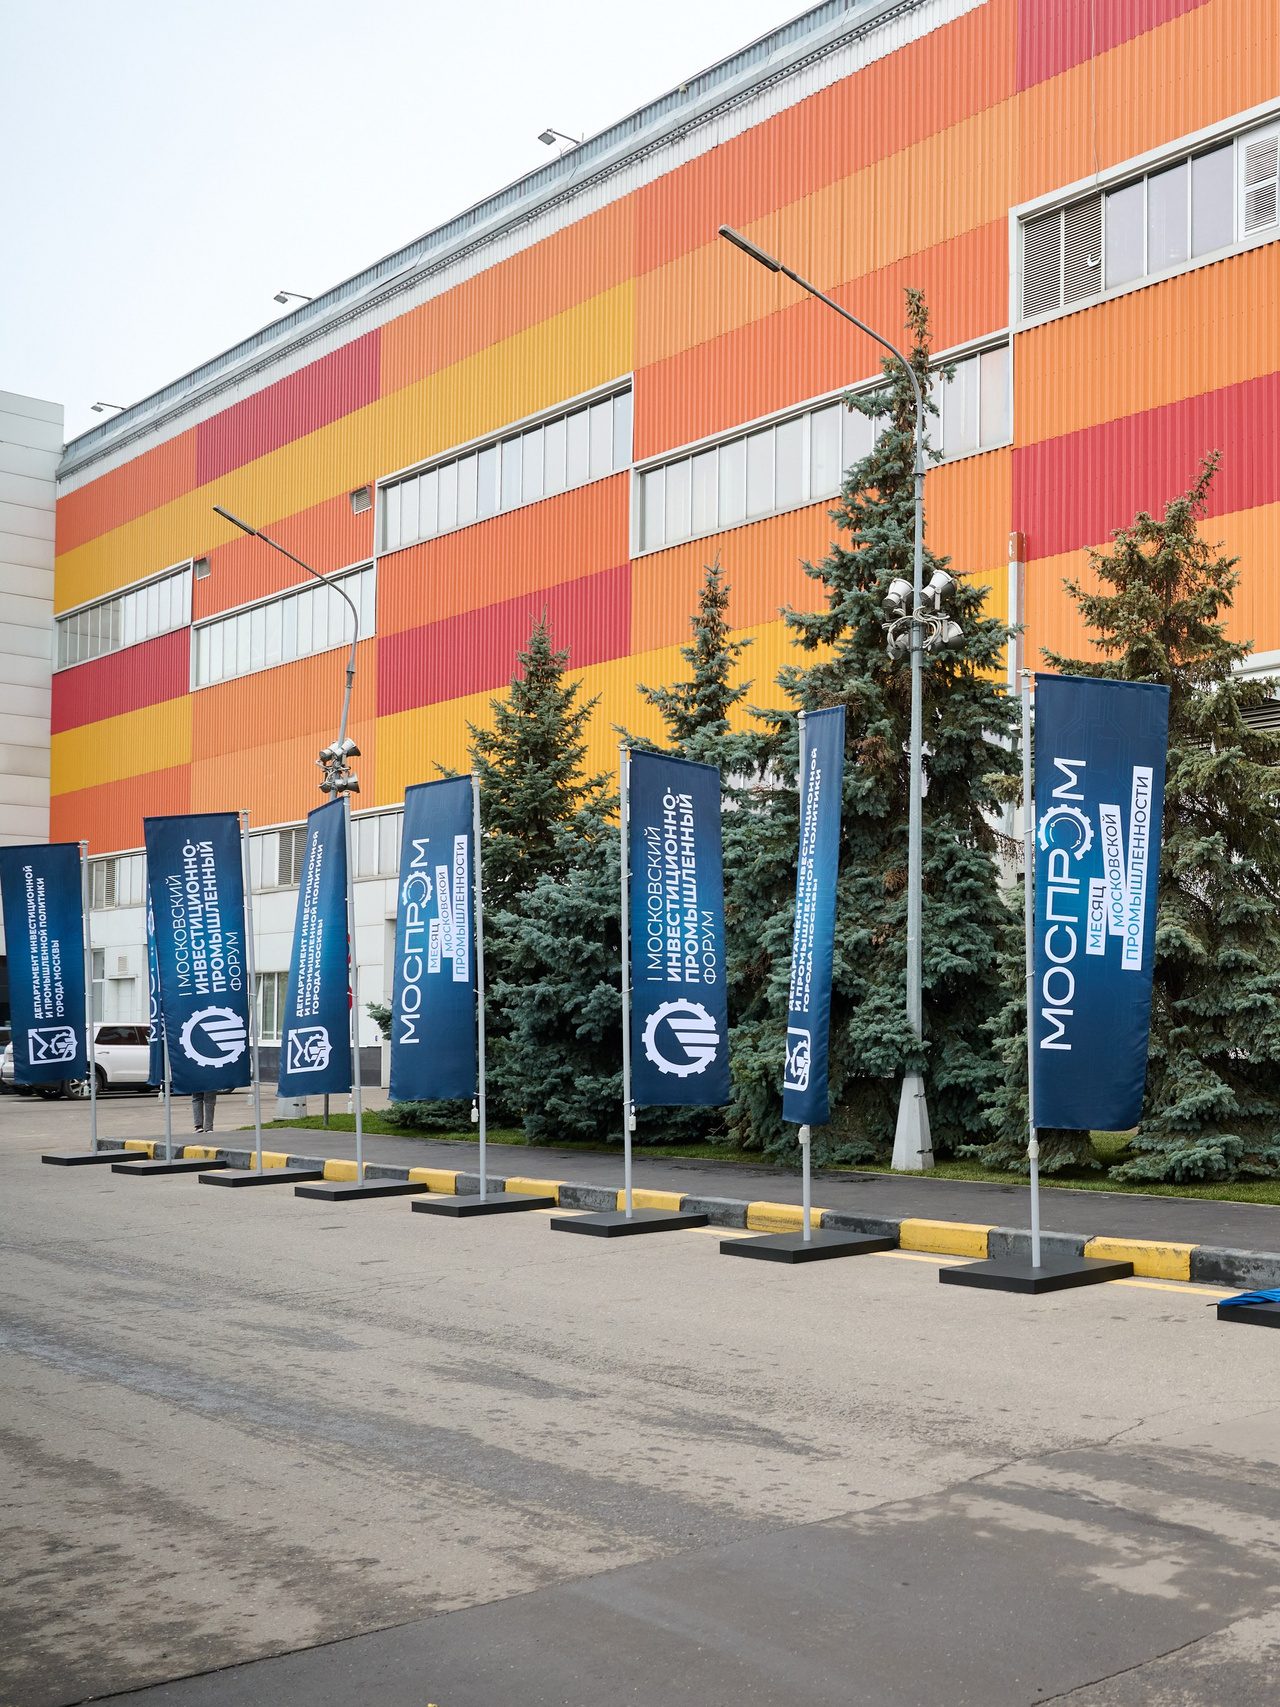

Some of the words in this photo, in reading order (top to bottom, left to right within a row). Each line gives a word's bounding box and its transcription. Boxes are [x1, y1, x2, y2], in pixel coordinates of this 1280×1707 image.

[809, 769, 821, 854] ПОЛИТИКИ
[23, 865, 39, 953] ИНВЕСТИЦИОННОЙ
[36, 877, 47, 927] ПОЛИТИКИ
[312, 844, 324, 904] ПОЛИТИКИ
[456, 841, 466, 975] ПРОМЫШЛЕННОСТИ
[644, 826, 663, 969] МОСКОВСКИЙ
[663, 787, 682, 982] ИНВЕСТИЦИОННО-
[675, 793, 700, 983] ПРОМЫШЛЕННЫЙ
[789, 900, 803, 1011] ДЕПАРТАМЕНТ
[798, 748, 817, 897] ИНВЕСТИЦИОННОЙ
[1101, 813, 1125, 927] МОСКОВСКОЙ
[1126, 776, 1149, 960] ПРОМЫШЛЕННОСТИ
[165, 874, 192, 988] МОСКОВСКИЙ
[182, 838, 210, 995] ИНВЕСТИЦИОННО-
[196, 841, 227, 993] ПРОМЫШЛЕННЫЙ
[296, 938, 308, 1017] ДЕПАРТАМЕНТ
[302, 831, 319, 935] ИНВЕСТИЦИОННОЙ
[315, 919, 323, 971] МОСКВЫ
[430, 923, 440, 968] МЕСЯЦ
[437, 871, 452, 952] МОСКОВСКОЙ
[701, 910, 717, 985] ФОРУМ
[796, 858, 814, 996] ПРОМЫШЛЕННОЙ
[803, 950, 812, 1013] ГОРОДА
[808, 878, 818, 947] МОСКВЫ
[1089, 886, 1107, 948] МЕСЯЦ
[31, 955, 43, 1019] ДЕПАРТАМЕНТ
[37, 929, 53, 1010] ПРОМЫШЛЕННОЙ
[51, 940, 62, 980] МОСКВЫ
[225, 932, 242, 991] ФОРУМ
[305, 906, 318, 1005] ПРОМЫШЛЕННОЙ
[312, 974, 320, 1015] ГОРОДА
[55, 982, 64, 1017] ГОРОДА
[304, 1008, 310, 1016] И
[795, 1003, 801, 1012] И
